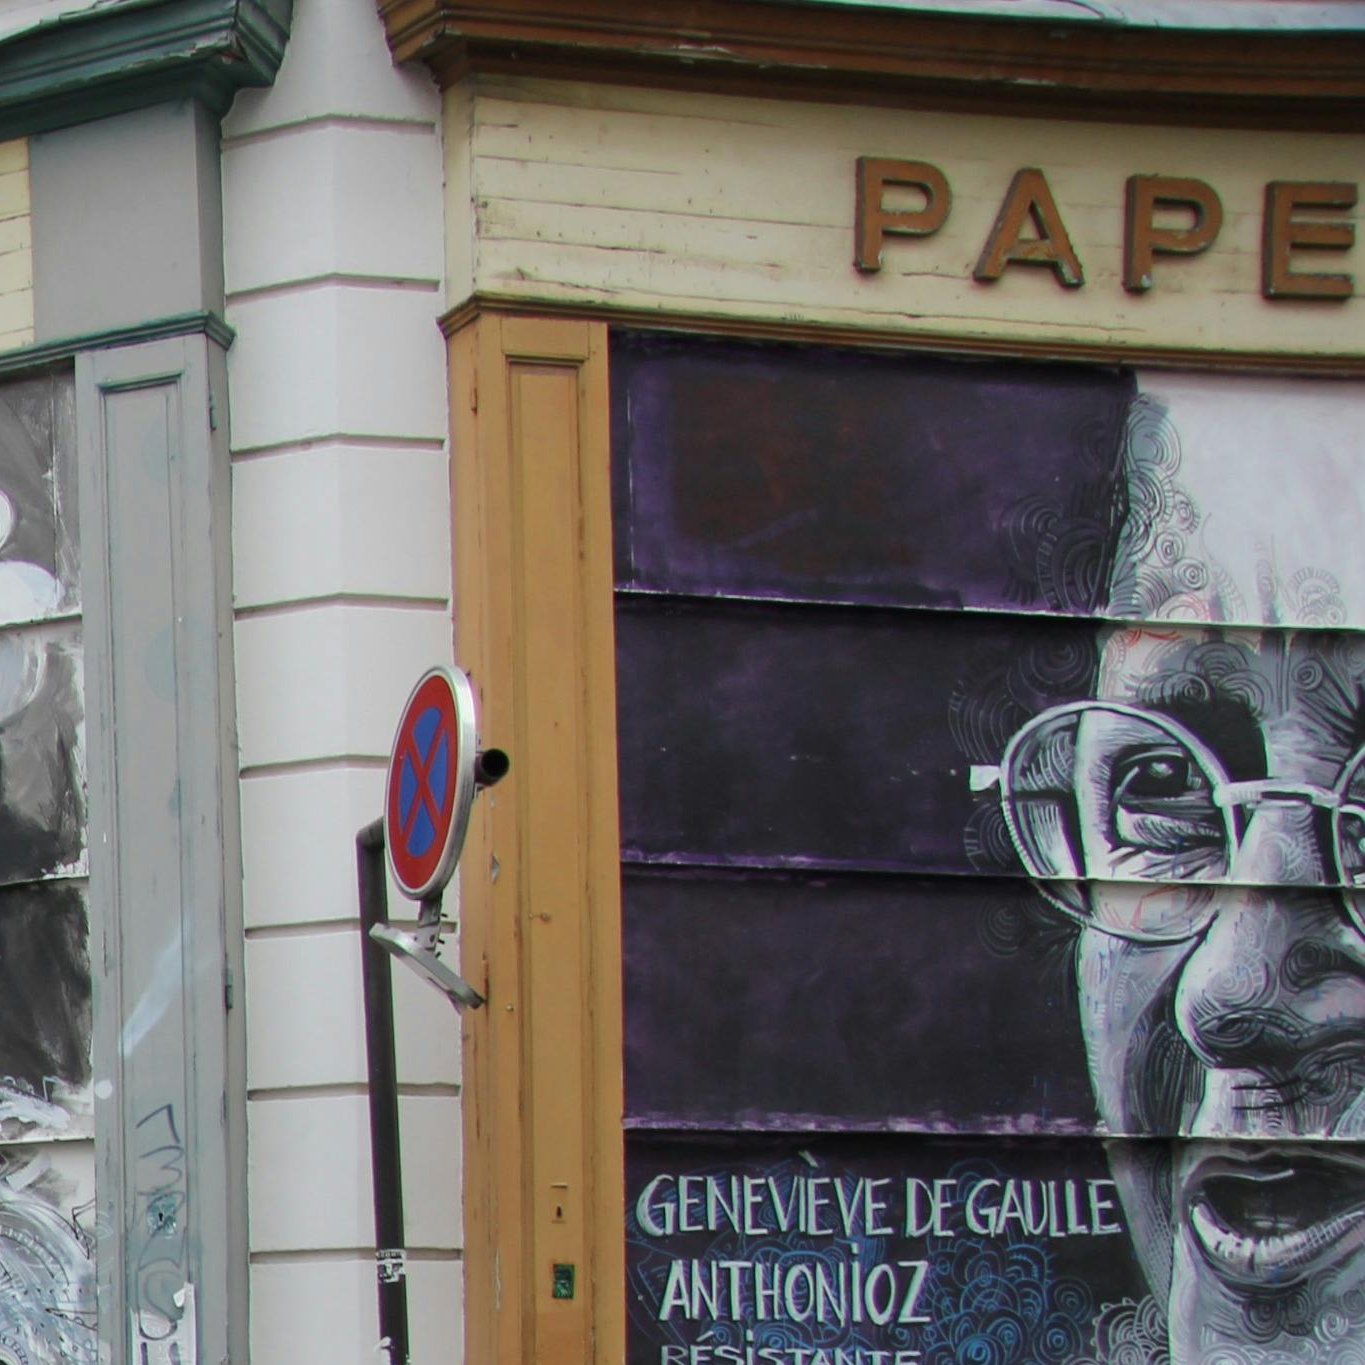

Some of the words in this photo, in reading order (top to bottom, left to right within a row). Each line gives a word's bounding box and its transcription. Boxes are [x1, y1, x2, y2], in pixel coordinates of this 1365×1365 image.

[853, 156, 1359, 301] PAPE
[636, 1151, 894, 1236] GENEVIÈVE
[906, 1176, 957, 1237] DE
[967, 1176, 1125, 1236] GAULLE
[660, 1244, 931, 1325] ANTHONIOZ
